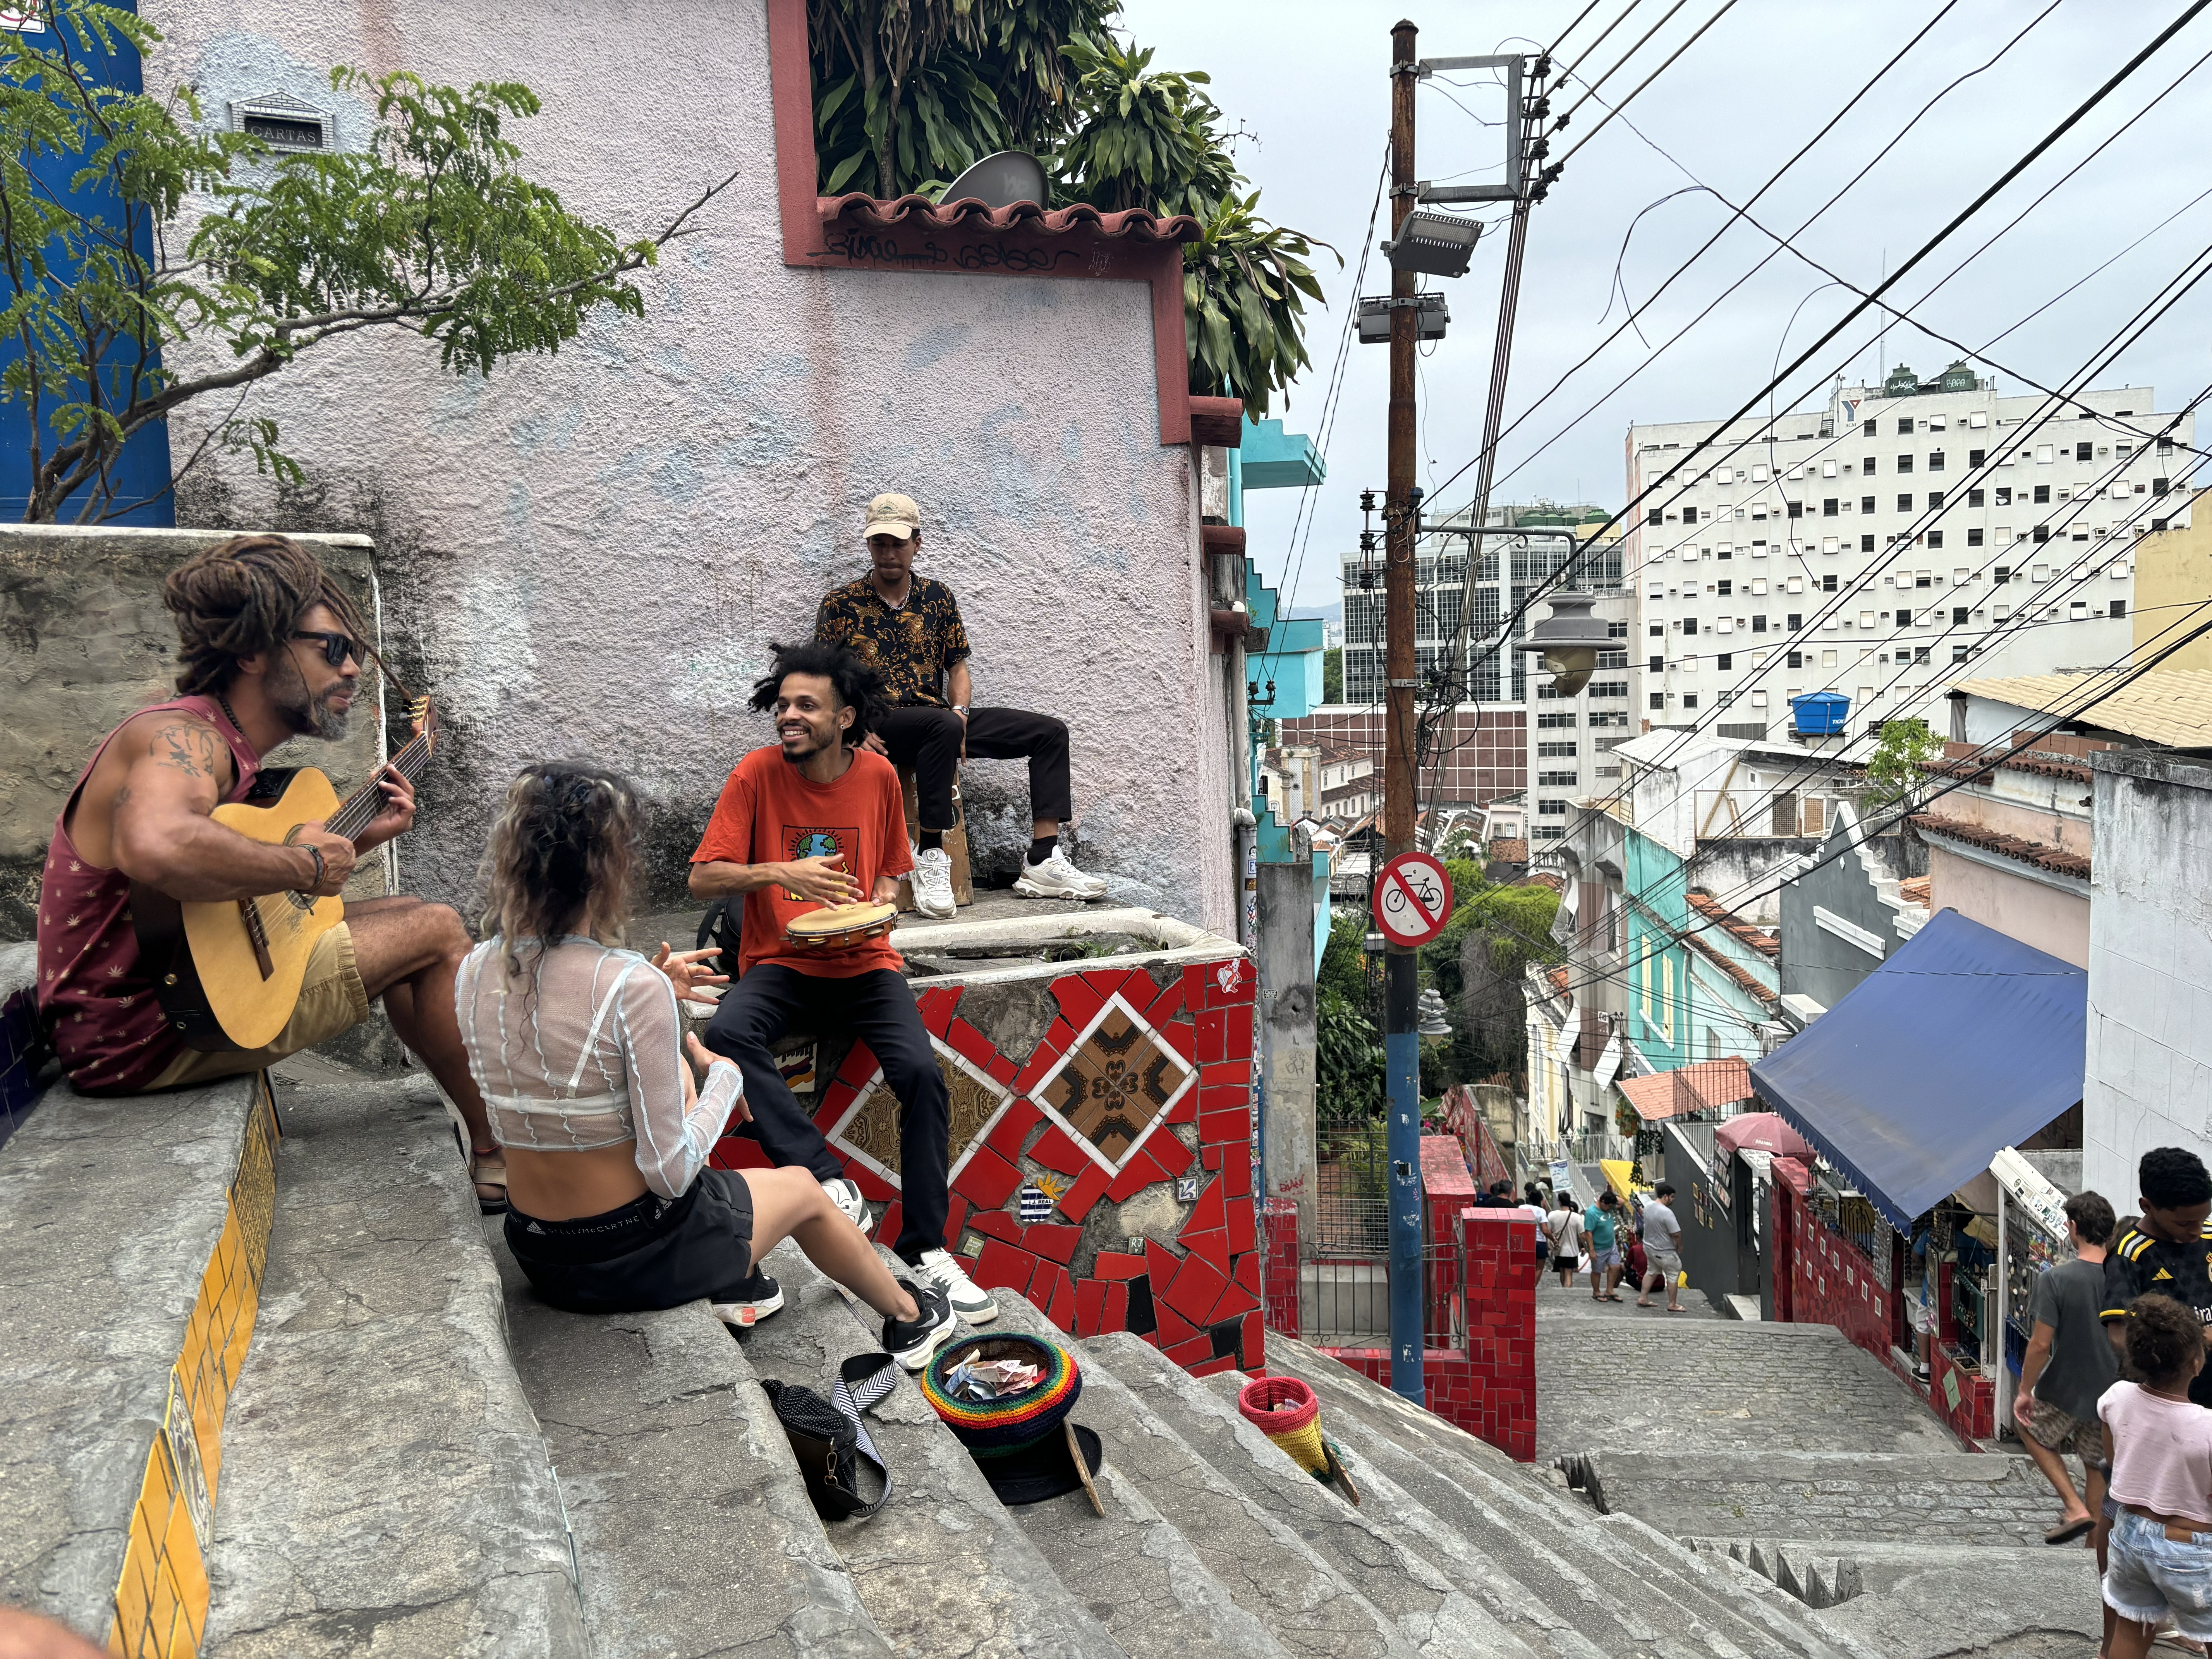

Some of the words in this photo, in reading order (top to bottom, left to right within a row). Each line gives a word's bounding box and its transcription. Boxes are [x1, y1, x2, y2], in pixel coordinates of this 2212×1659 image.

[251, 126, 316, 143] CARTAS
[1755, 1139, 1773, 1147] BRAHMA
[1131, 1238, 1144, 1247] RJ
